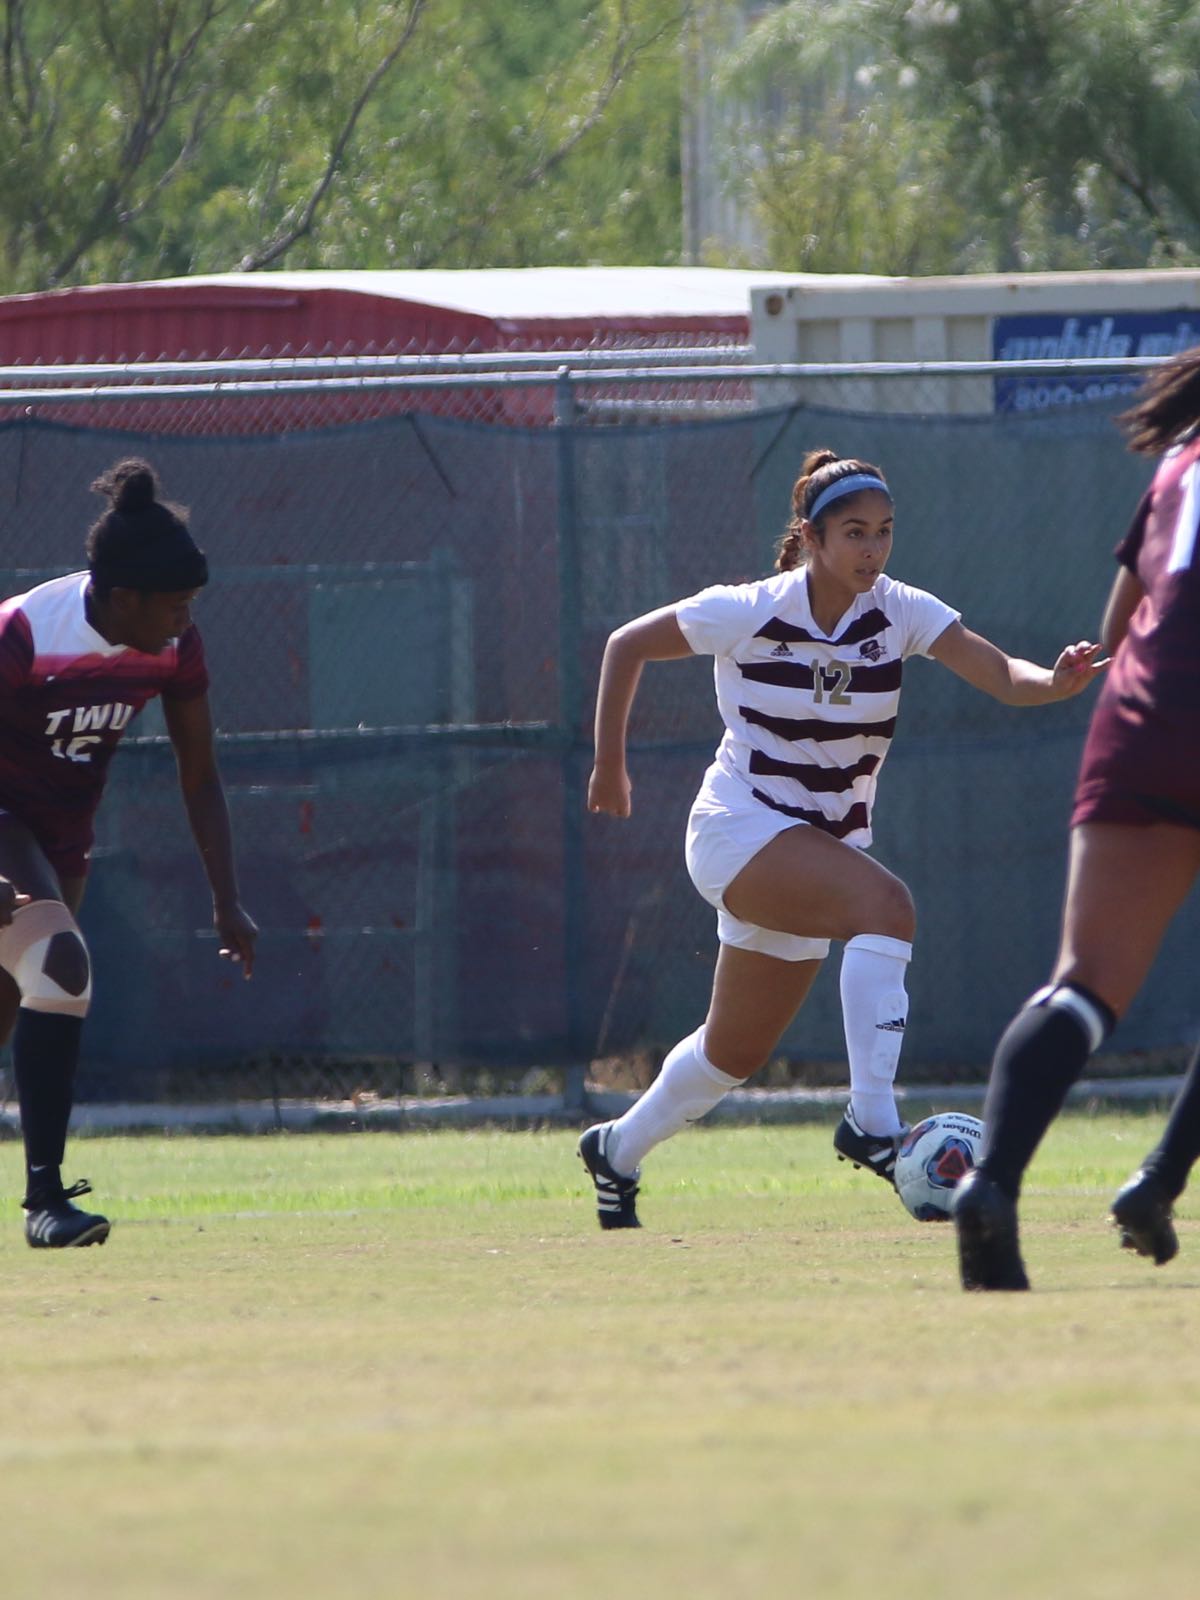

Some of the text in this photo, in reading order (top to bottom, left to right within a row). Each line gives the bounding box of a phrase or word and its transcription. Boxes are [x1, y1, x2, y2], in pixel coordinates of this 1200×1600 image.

[809, 658, 852, 705] 12
[44, 702, 132, 735] TWU
[942, 1123, 982, 1139] Wilson
